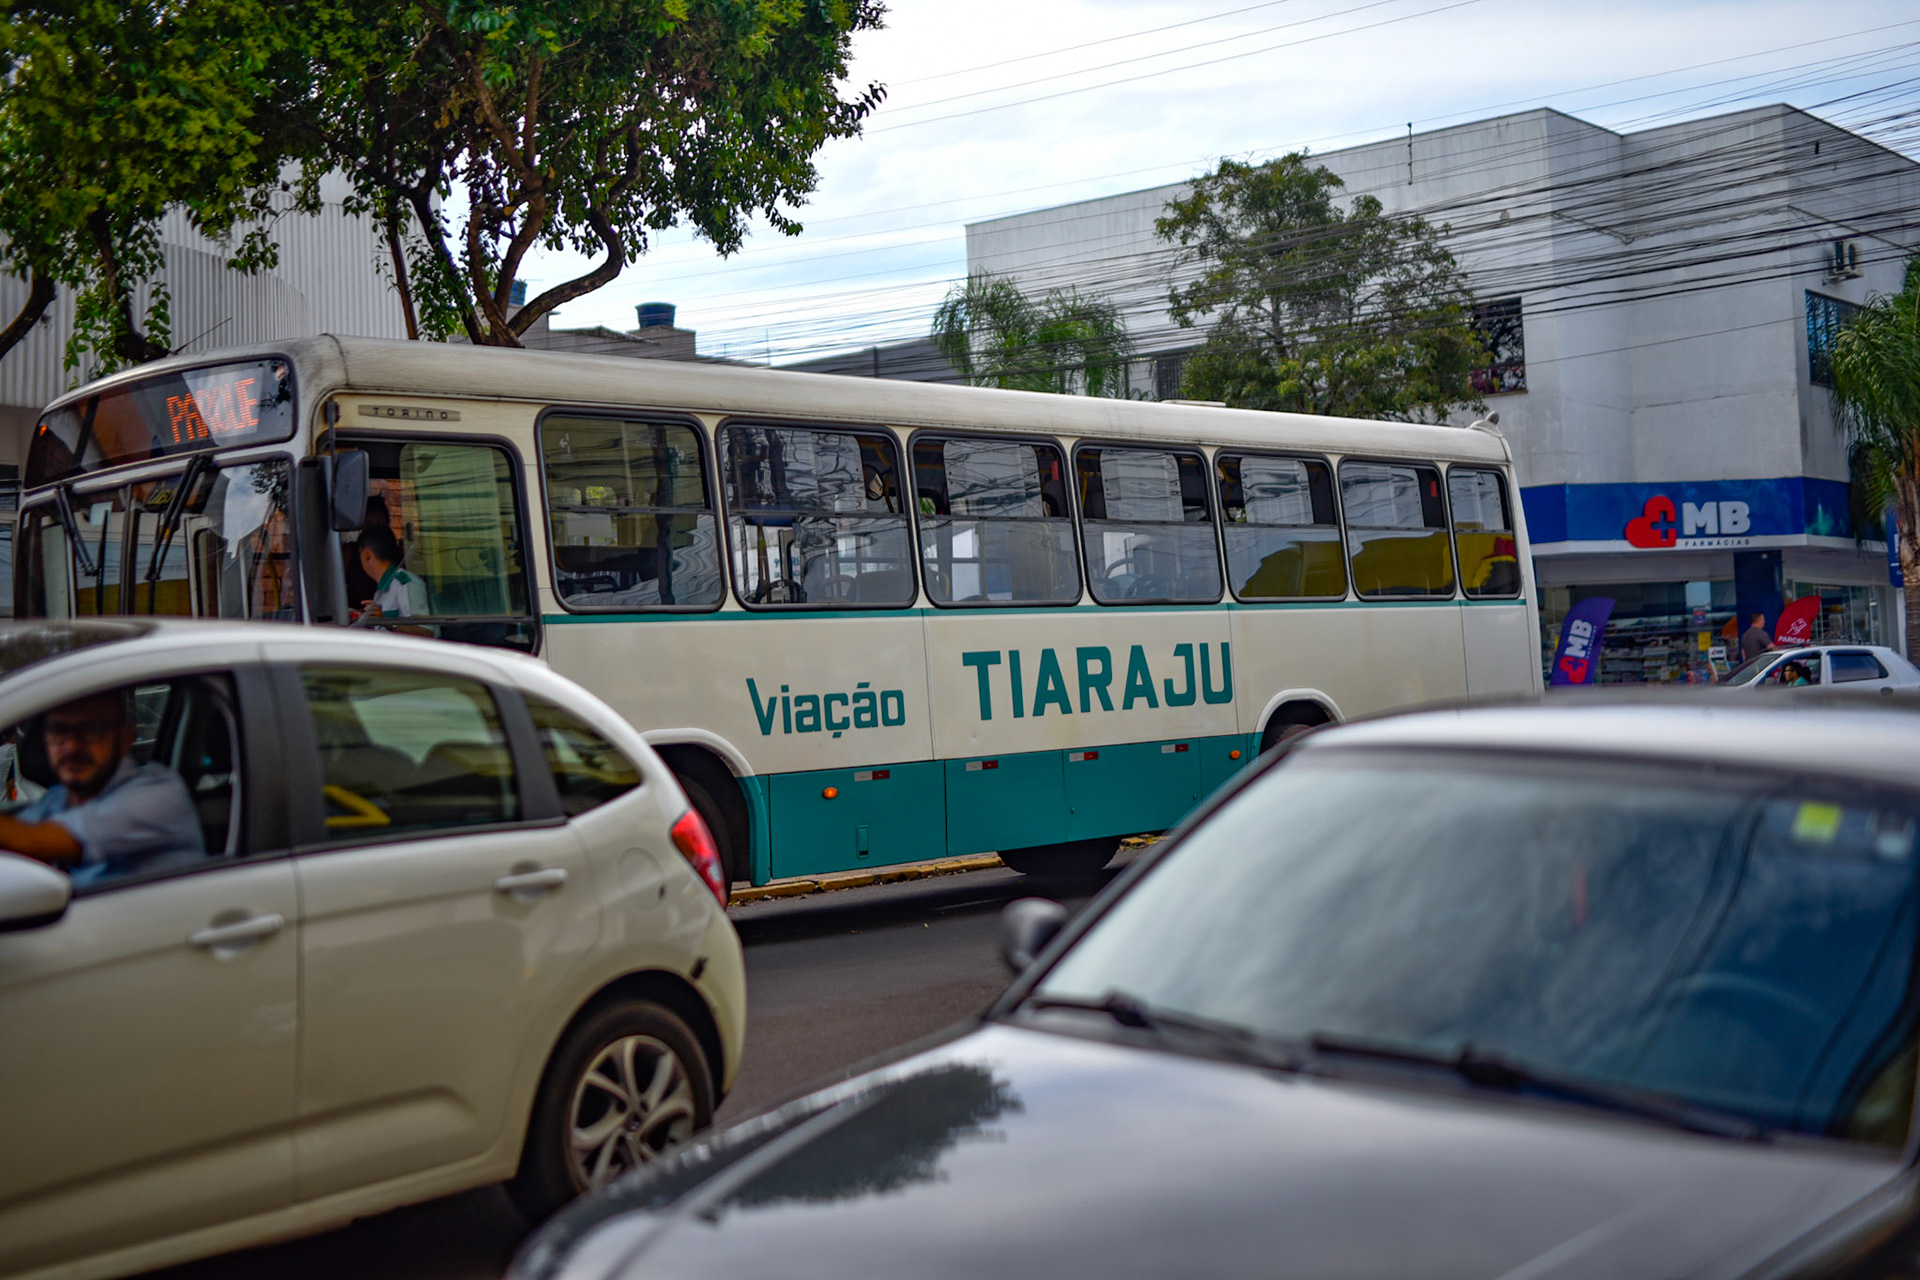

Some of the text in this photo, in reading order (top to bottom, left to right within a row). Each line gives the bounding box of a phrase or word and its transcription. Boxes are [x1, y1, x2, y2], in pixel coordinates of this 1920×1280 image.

[1682, 501, 1751, 536] MB
[1564, 619, 1593, 659] MB
[962, 642, 1233, 720] TIARAJU
